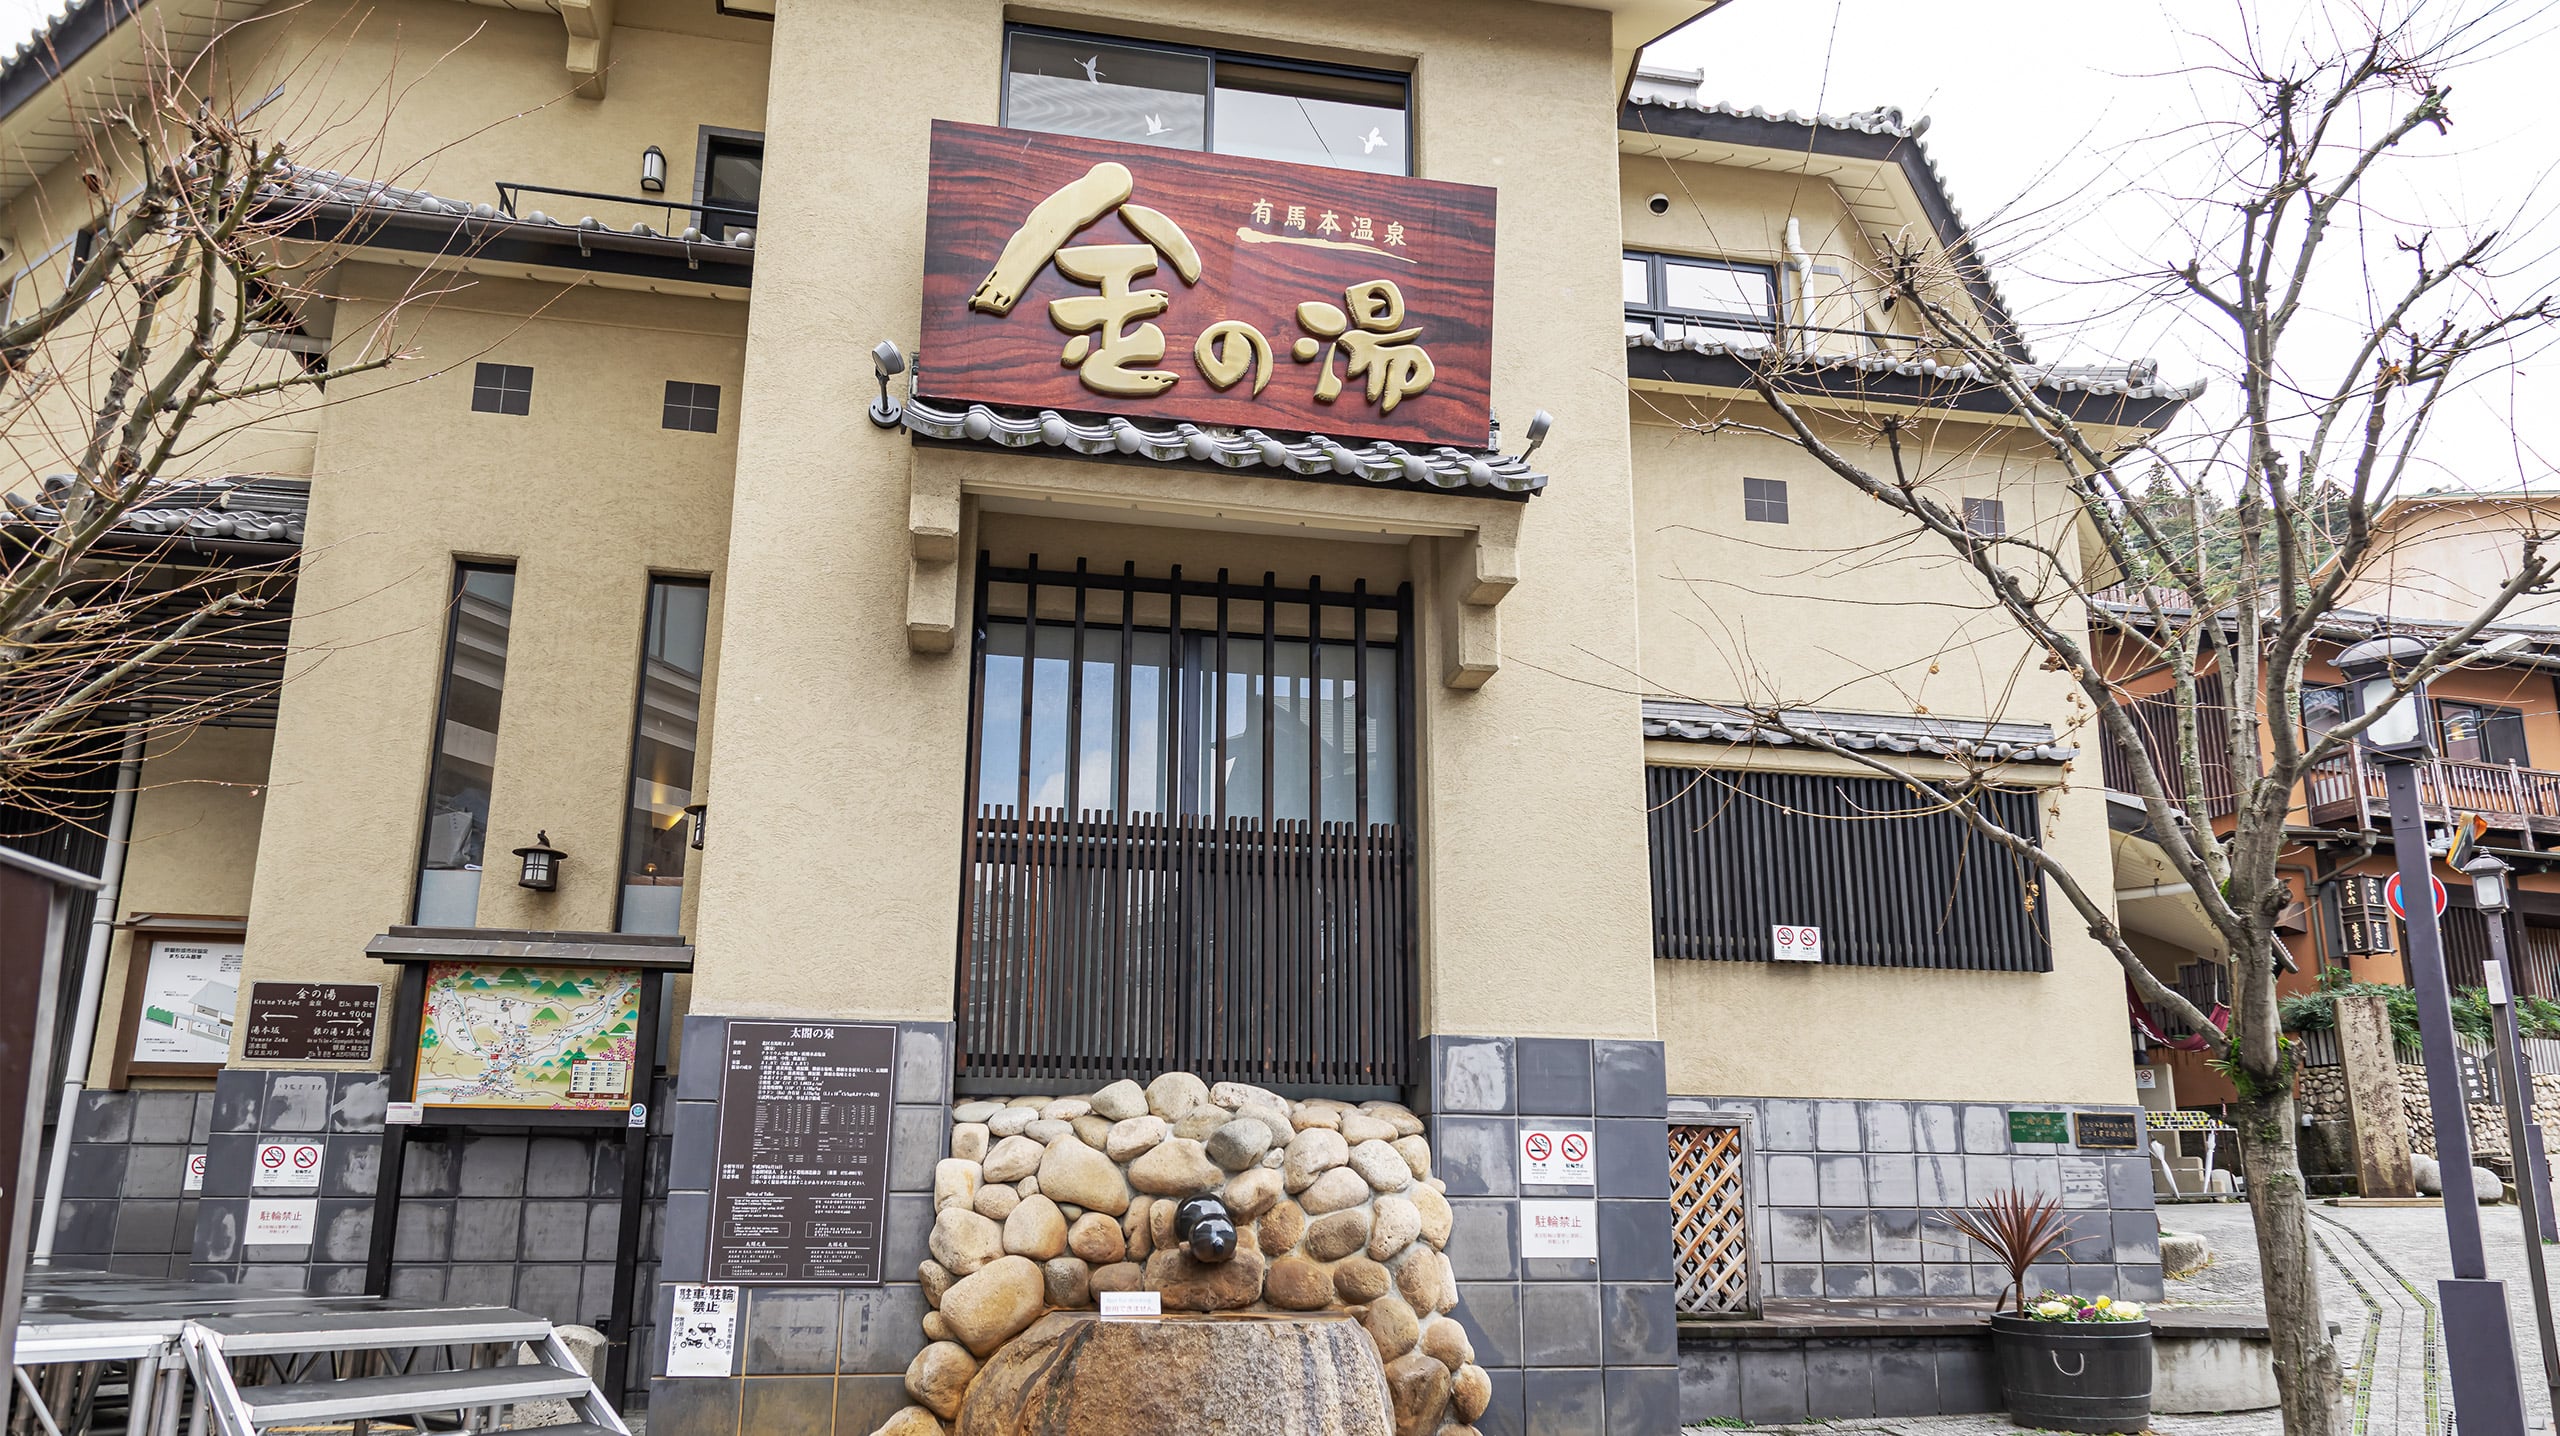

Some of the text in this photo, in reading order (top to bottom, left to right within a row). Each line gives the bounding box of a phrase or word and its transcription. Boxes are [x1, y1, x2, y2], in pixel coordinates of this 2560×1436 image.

[1249, 198, 1408, 247] 有馬本温泉
[968, 160, 1436, 416] 金の湯
[296, 987, 337, 1001] 金の湯
[250, 1025, 280, 1035] 湯本坂
[790, 1027, 835, 1039] 太閤の泉
[259, 1210, 302, 1222] 駐輪禁止
[1535, 1215, 1582, 1228] 駐輪禁止
[693, 1301, 720, 1314] 禁止
